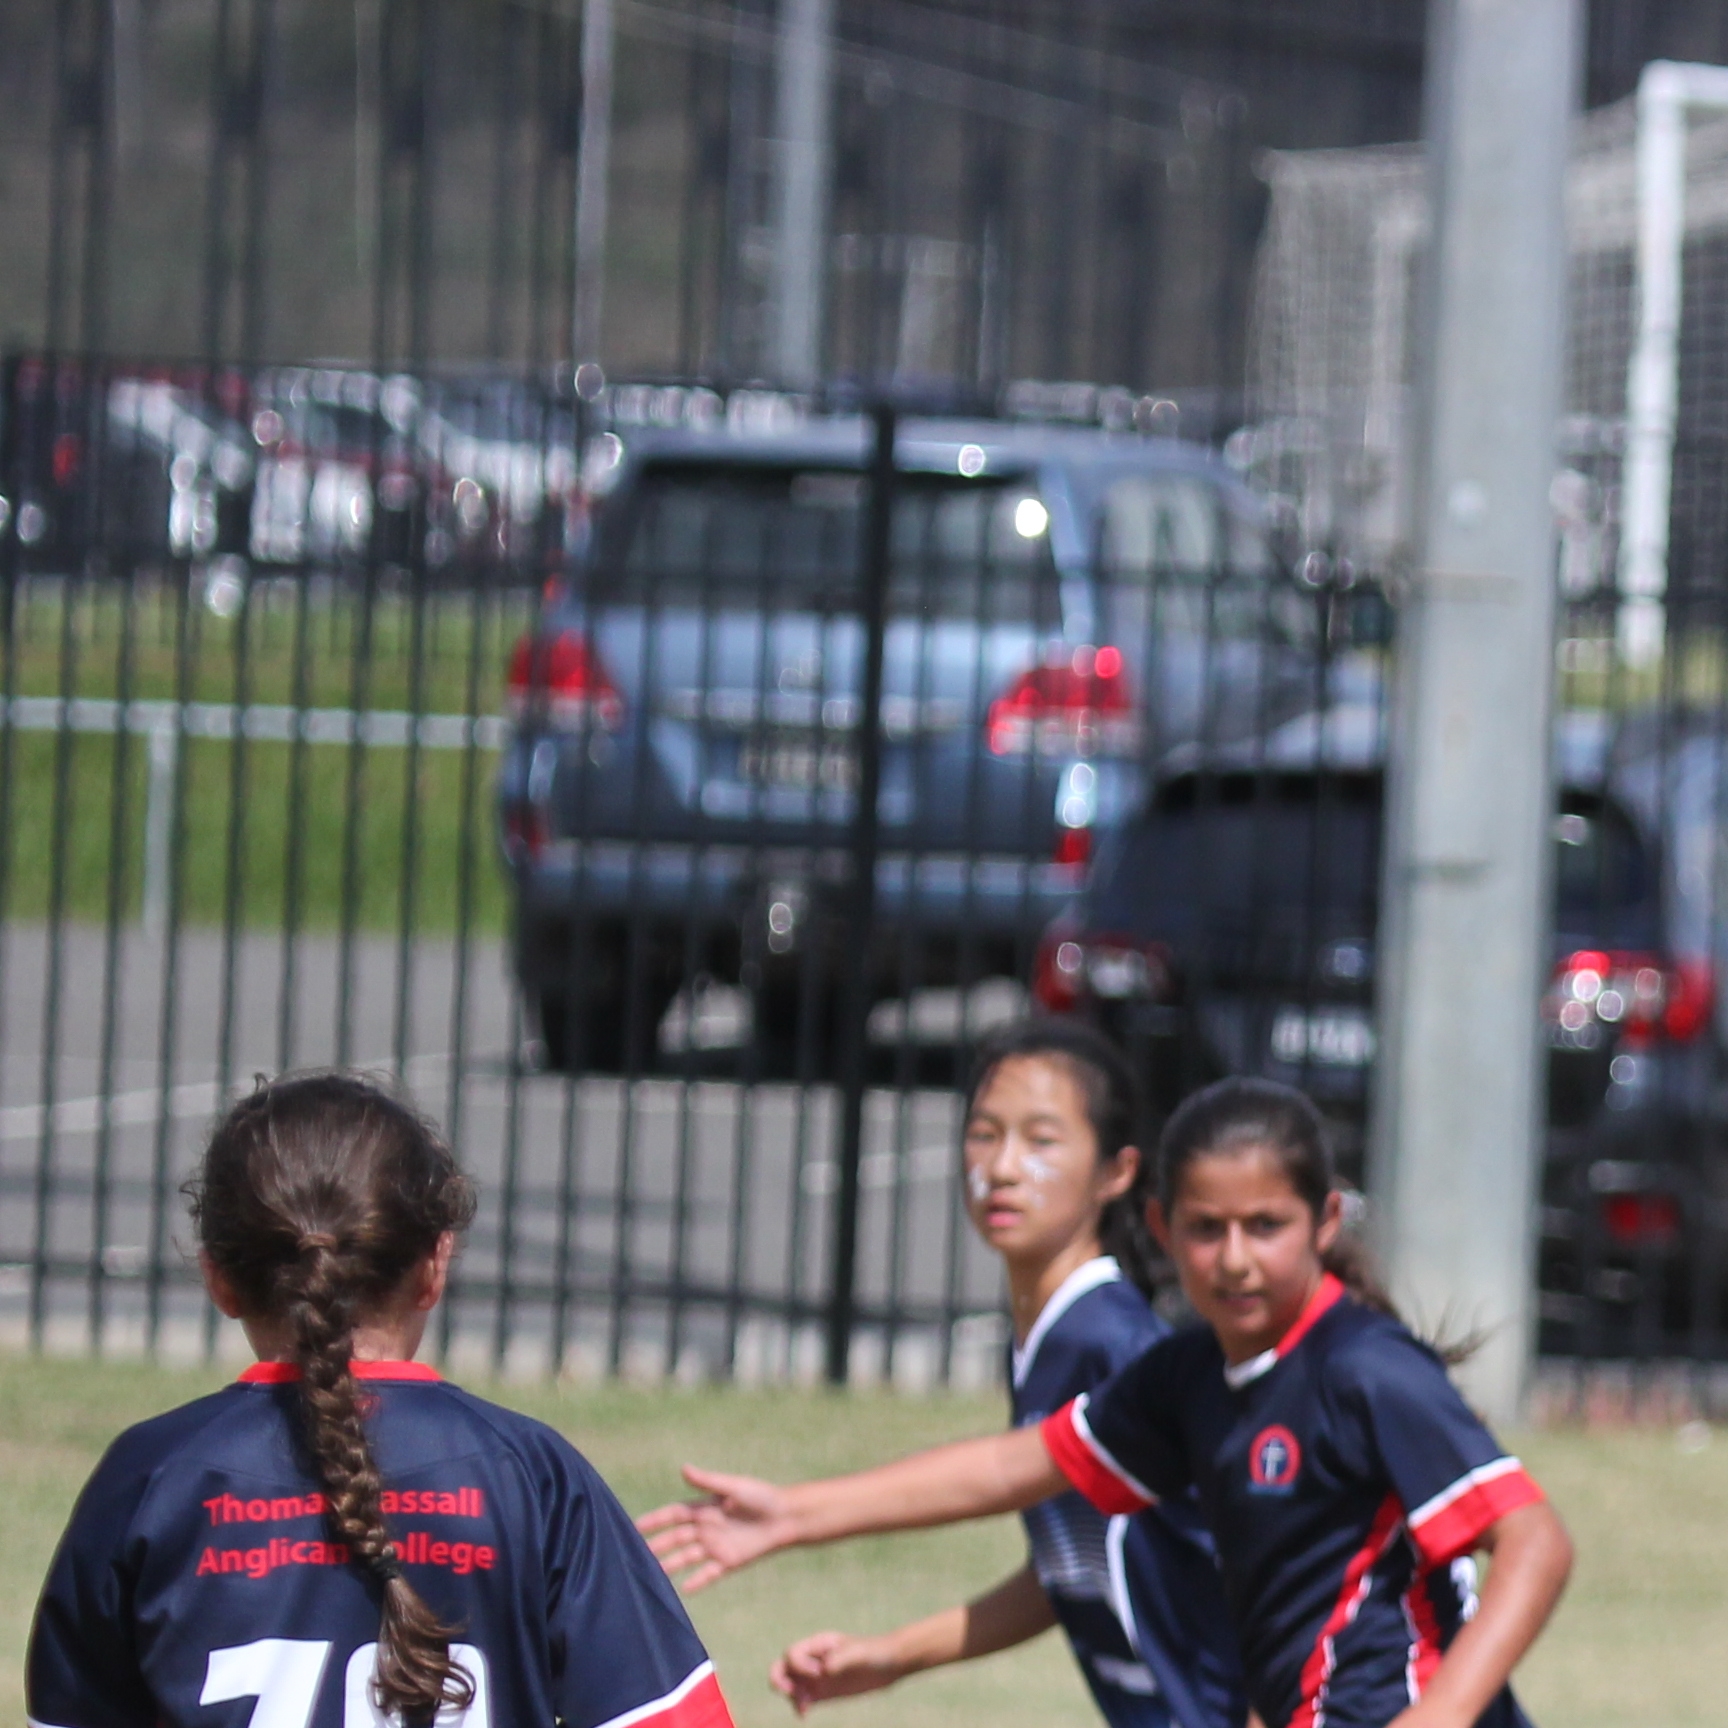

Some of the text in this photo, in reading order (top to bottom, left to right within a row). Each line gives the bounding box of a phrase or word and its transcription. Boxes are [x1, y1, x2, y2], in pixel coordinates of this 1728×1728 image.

[203, 1487, 483, 1526] Thoma assall
[390, 1532, 496, 1575] ollege
